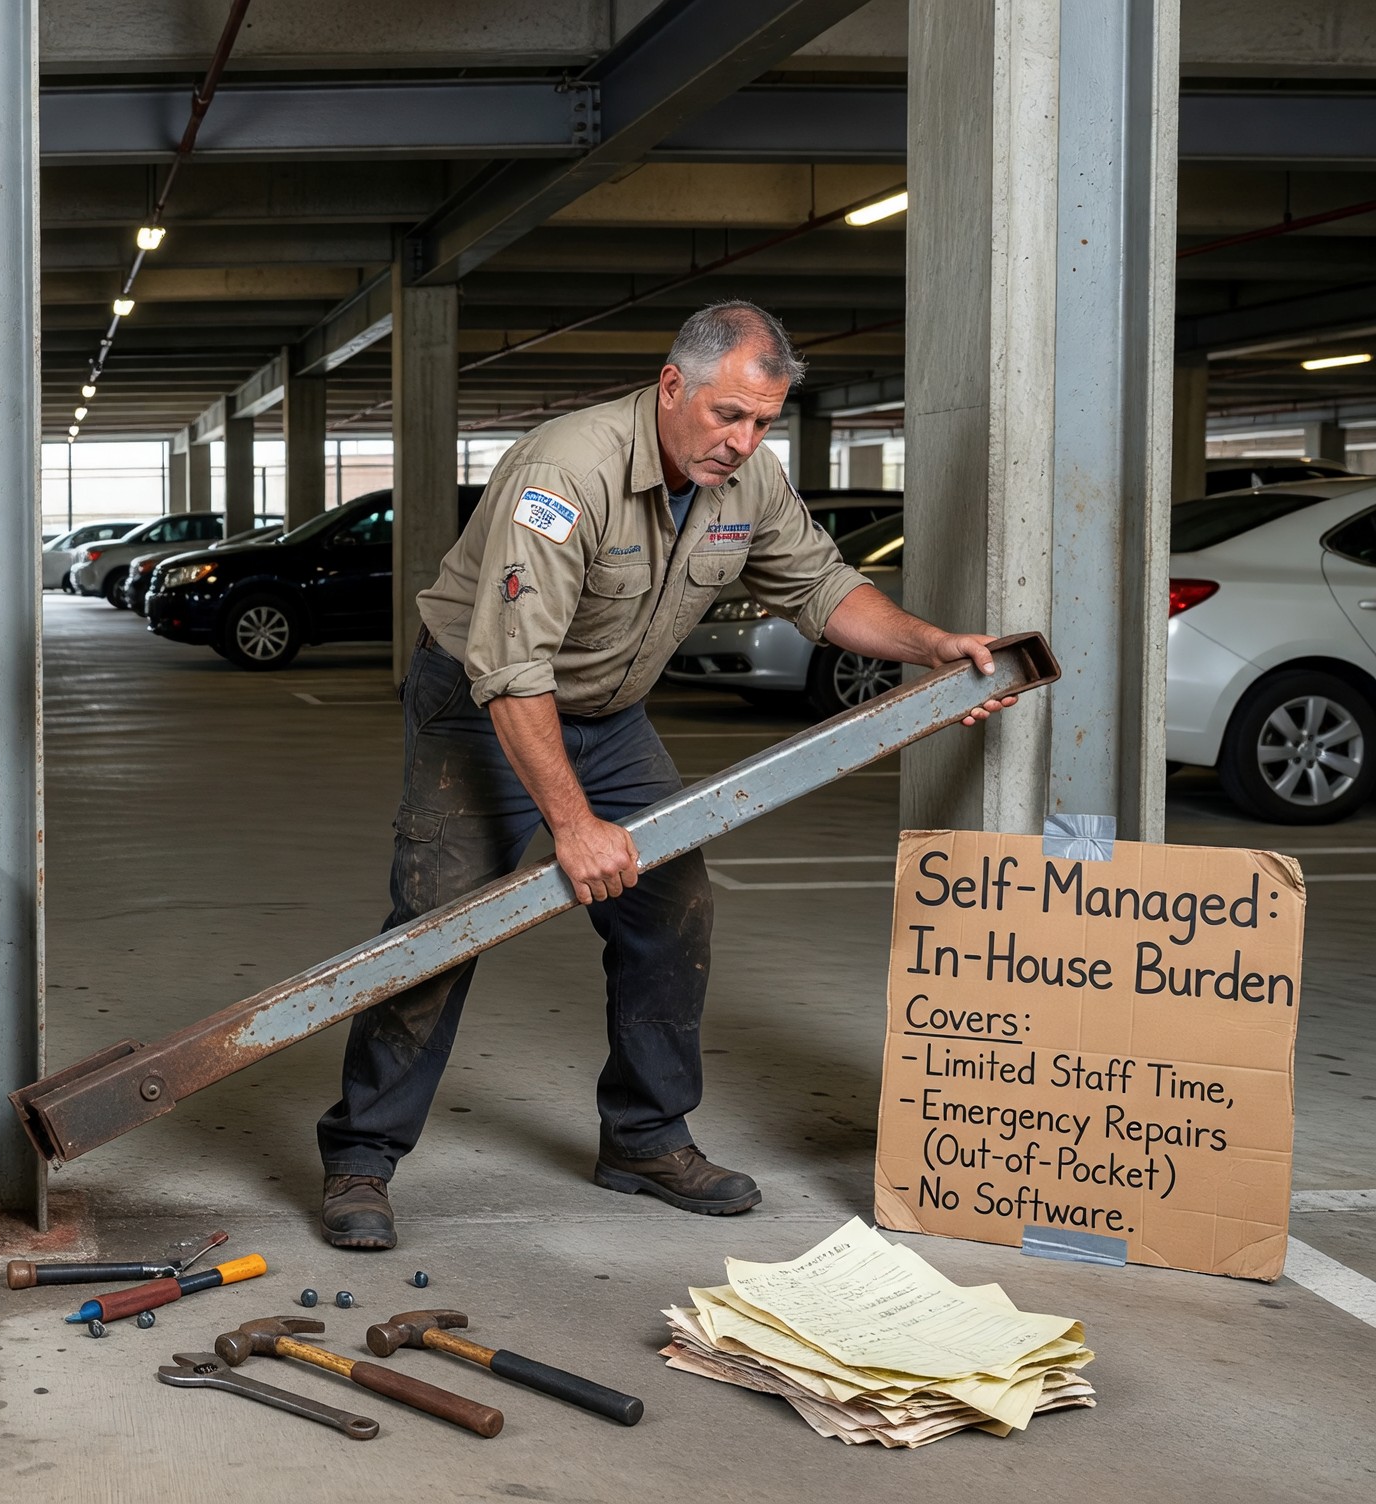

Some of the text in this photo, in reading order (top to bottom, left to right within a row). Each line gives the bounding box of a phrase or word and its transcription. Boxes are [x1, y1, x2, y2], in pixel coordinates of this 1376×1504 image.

[915, 850, 1280, 946] Self-Managed:
[906, 925, 1295, 1008] In-House Burden
[905, 994, 1032, 1037] Covers:
[1050, 1053, 1137, 1094] Staff
[1147, 1062, 1235, 1110] Time,
[1105, 1104, 1229, 1156] Repairs
[923, 1126, 1177, 1201] (Out-of-Pocket)
[973, 1181, 1136, 1234] Software.
